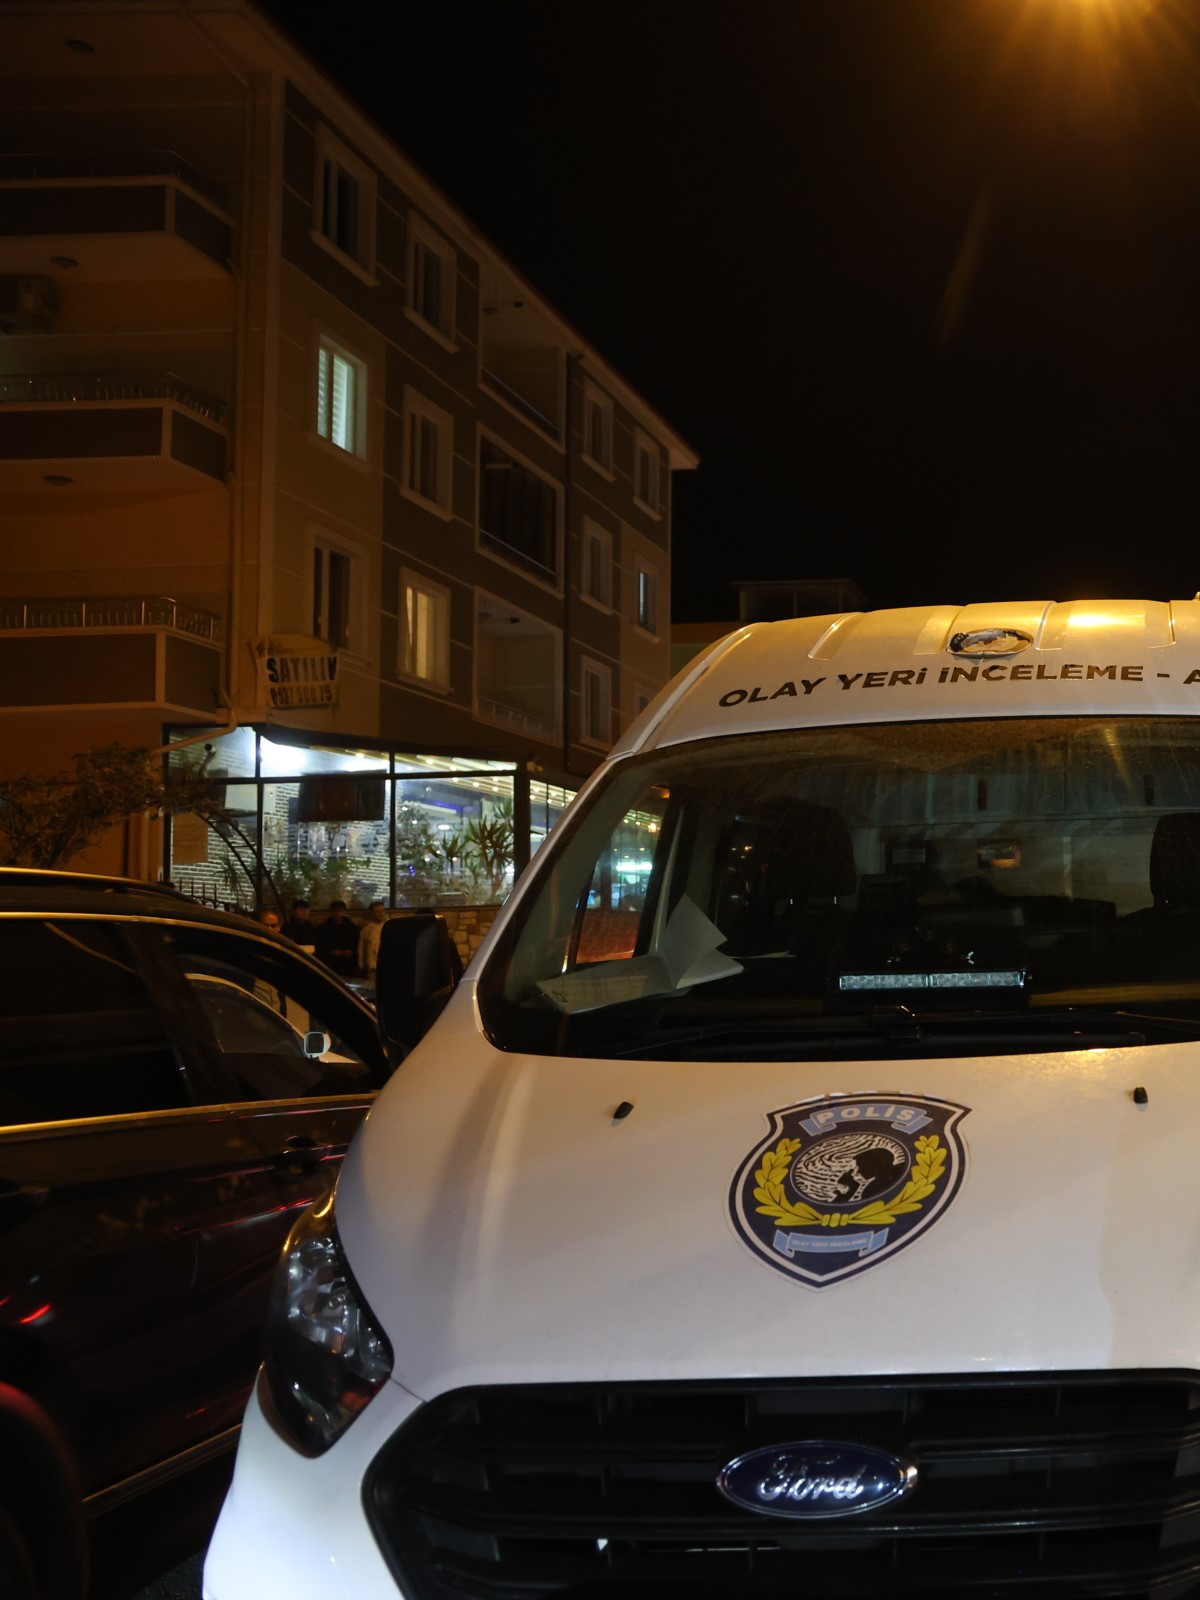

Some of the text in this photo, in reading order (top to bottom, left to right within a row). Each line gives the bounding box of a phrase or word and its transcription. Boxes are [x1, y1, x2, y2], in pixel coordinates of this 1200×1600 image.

[718, 677, 827, 707] OLAY
[838, 667, 928, 690] YERİ
[937, 663, 1144, 683] İNCELEME
[816, 1104, 916, 1124] POLİS
[758, 1454, 867, 1500] Ford
